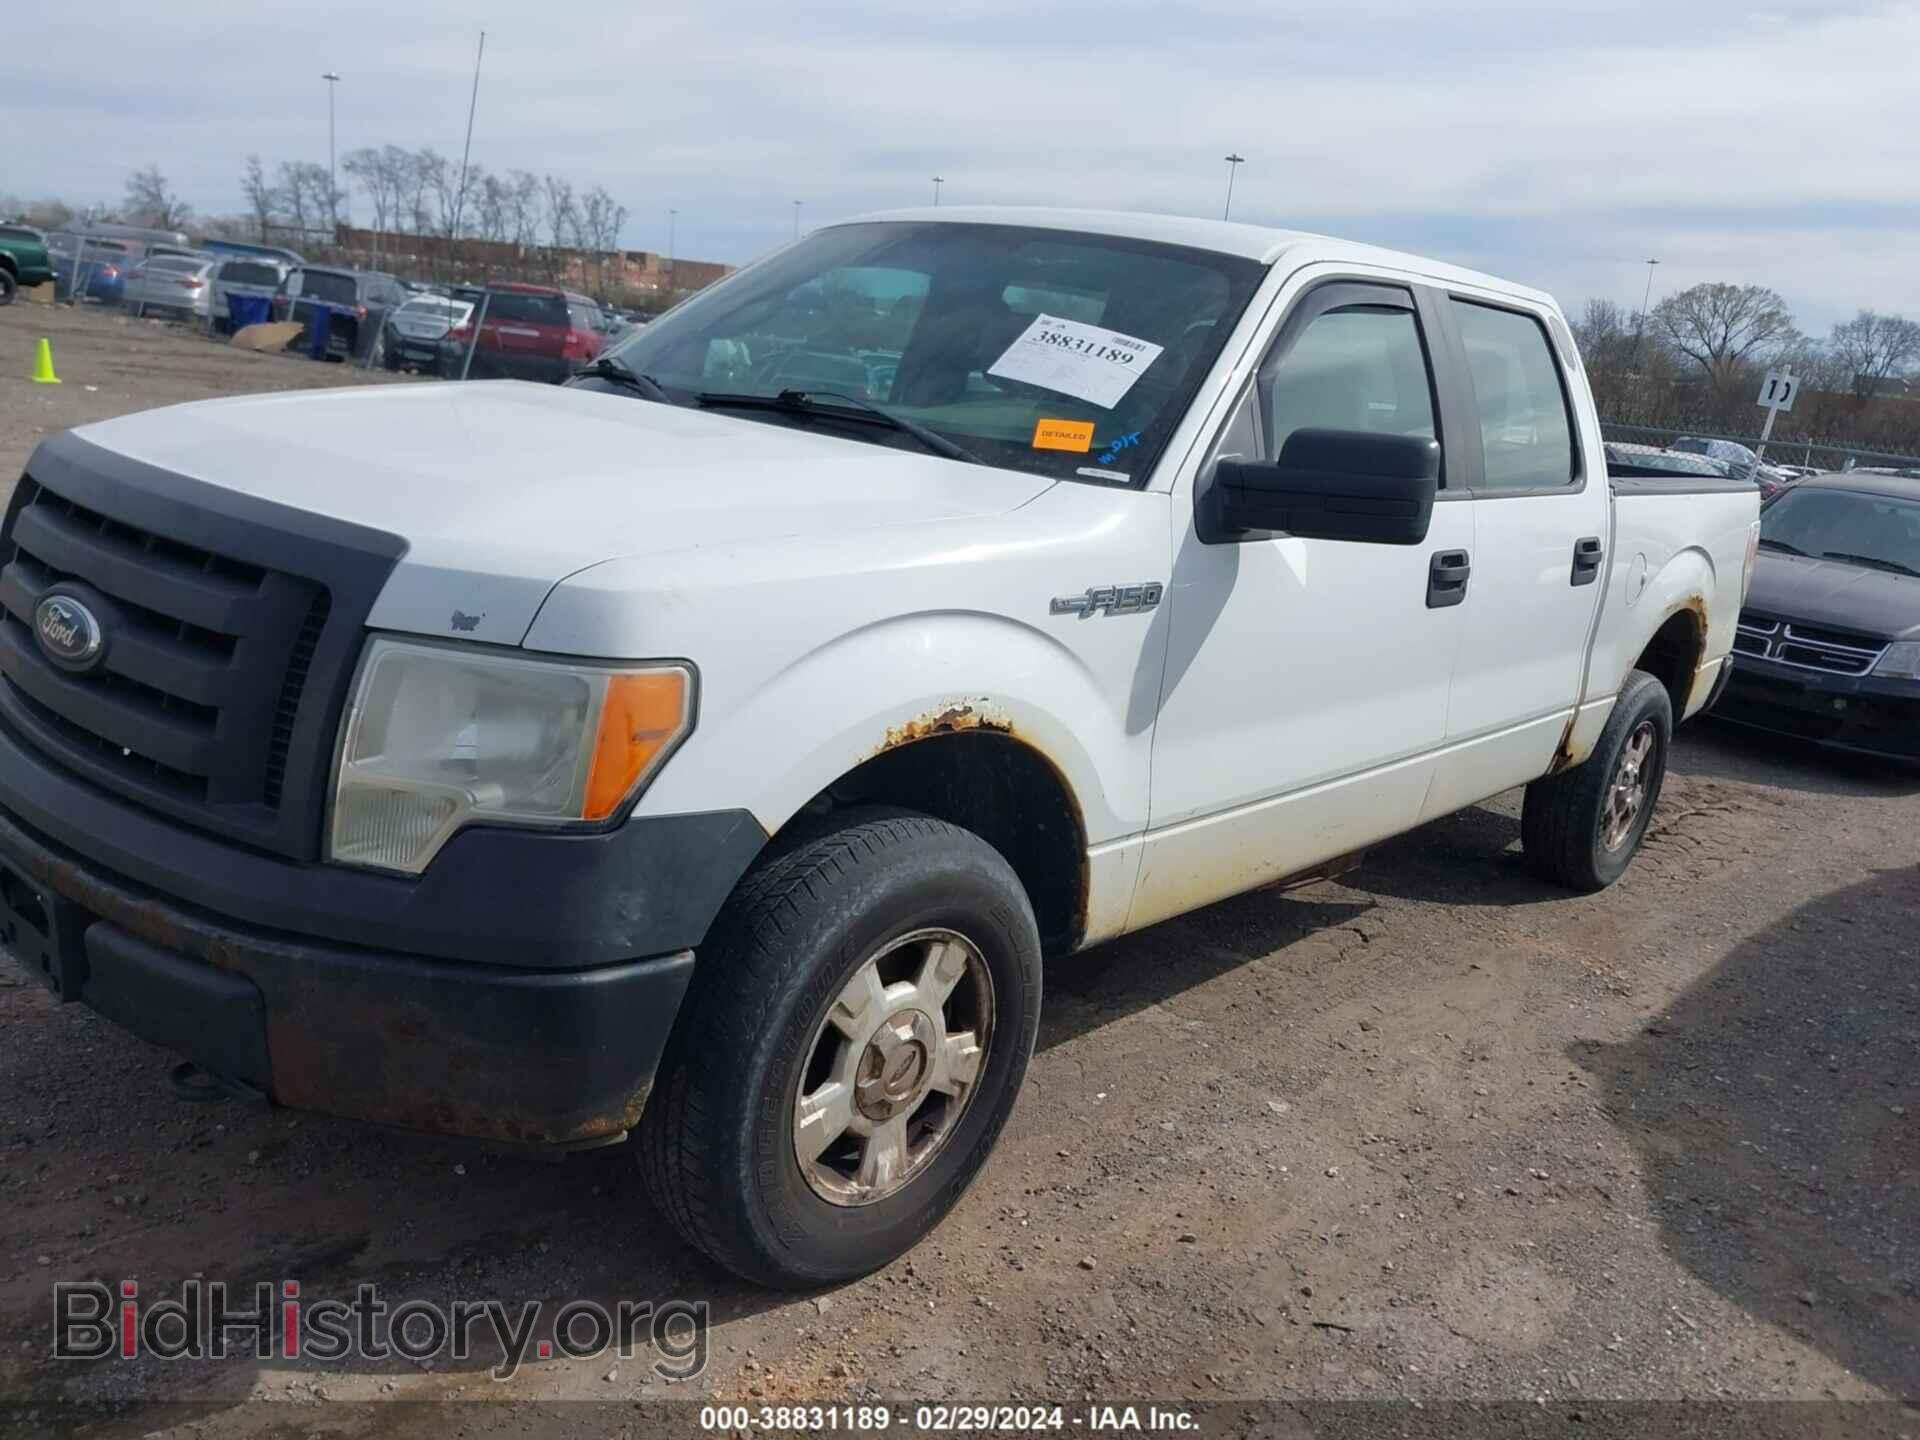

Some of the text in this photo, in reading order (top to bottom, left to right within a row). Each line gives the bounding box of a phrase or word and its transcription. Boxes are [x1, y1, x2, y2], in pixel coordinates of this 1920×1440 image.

[1032, 330, 1135, 365] 38831189
[1041, 430, 1087, 441] DETAILED
[42, 604, 79, 648] Ford
